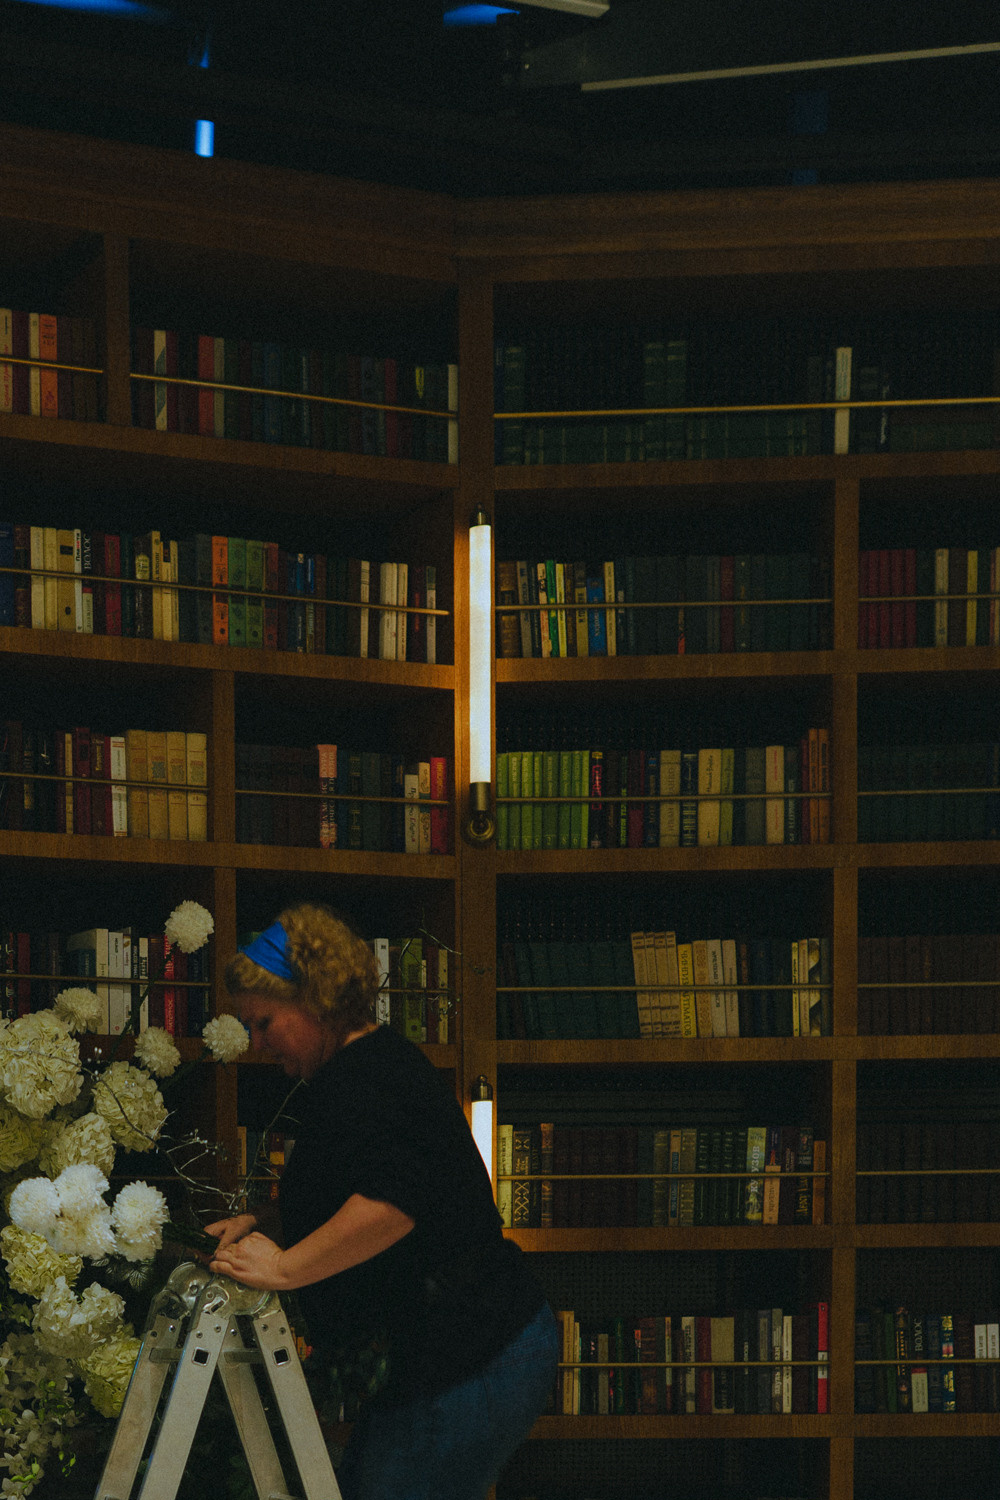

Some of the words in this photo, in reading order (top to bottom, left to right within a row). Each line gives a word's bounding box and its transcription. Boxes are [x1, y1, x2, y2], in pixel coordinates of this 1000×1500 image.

[84, 534, 92, 569] ВОЛОС
[751, 1146, 760, 1193] КУУЗОВ
[915, 1318, 923, 1351] ВОЛОС
